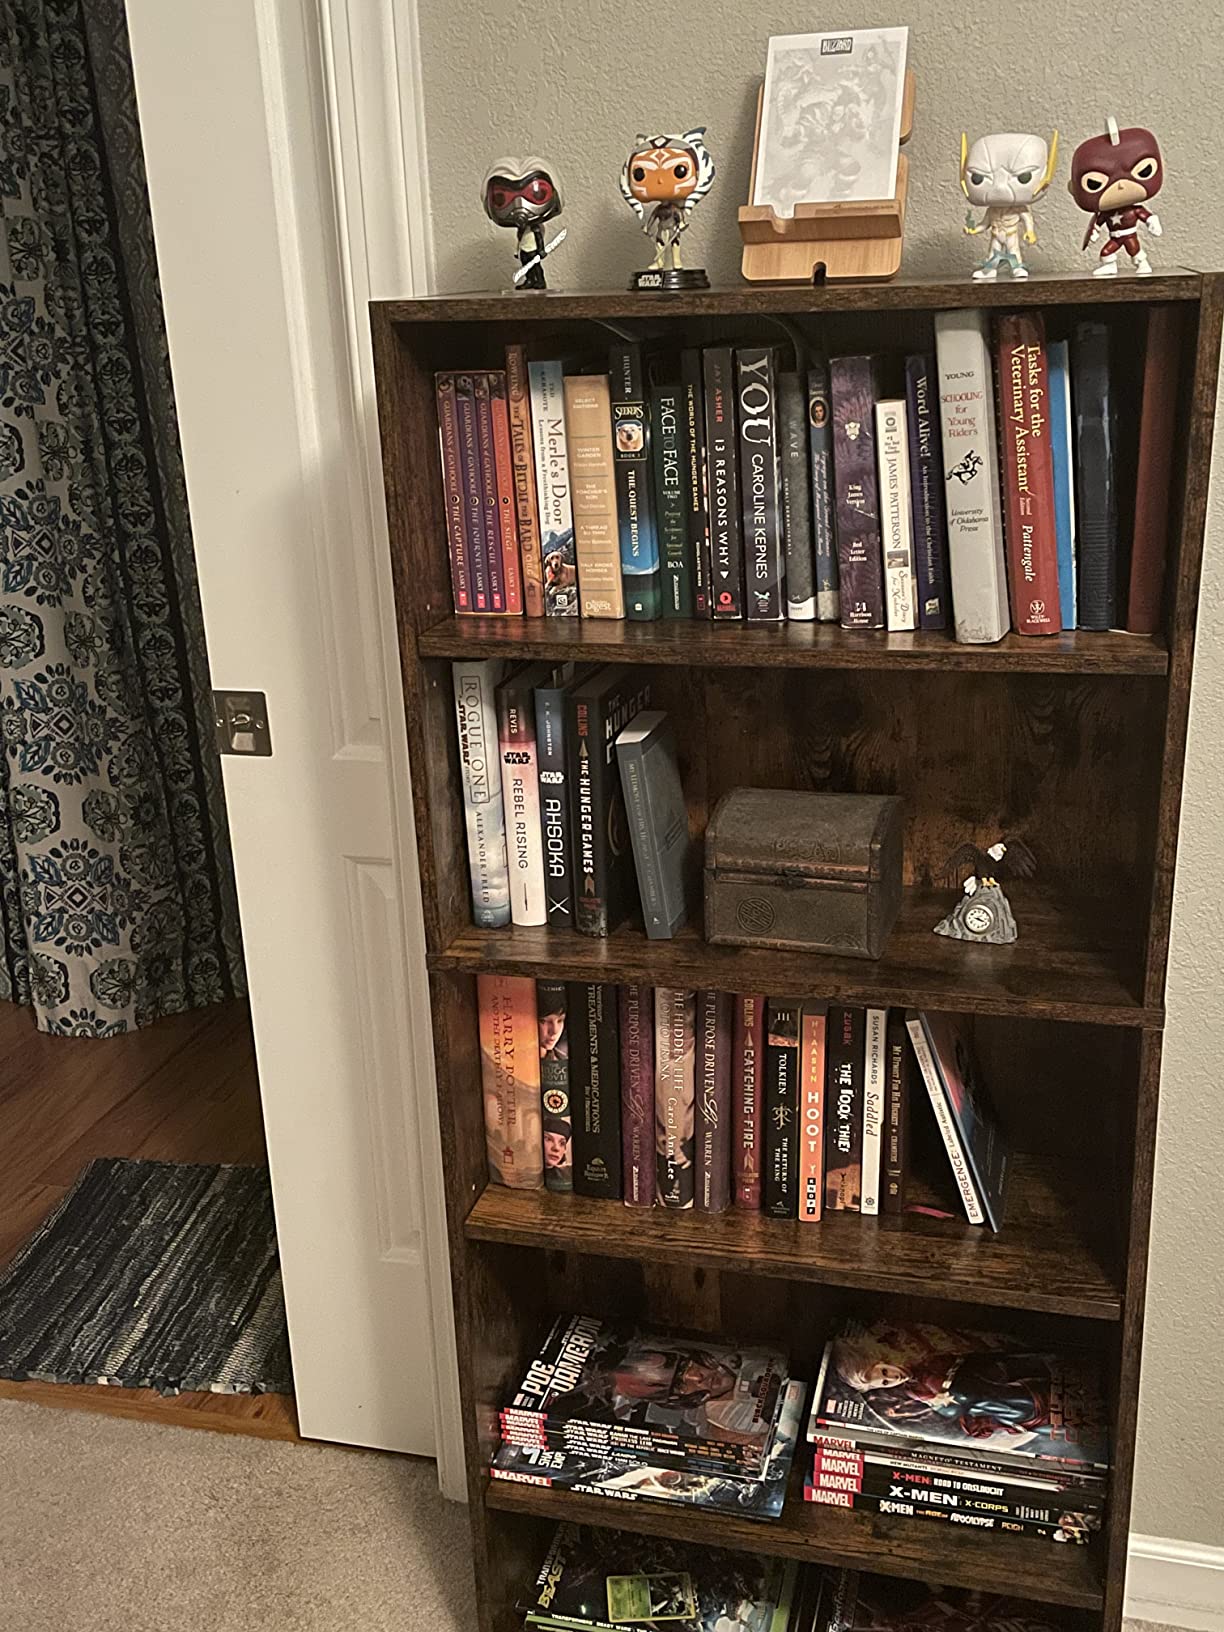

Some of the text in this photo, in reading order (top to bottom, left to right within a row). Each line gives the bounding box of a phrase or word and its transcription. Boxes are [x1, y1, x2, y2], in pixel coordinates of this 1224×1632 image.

[822, 39, 852, 53] BLIZZARD
[638, 279, 662, 287] WARS
[508, 353, 520, 396] ROWLING
[623, 355, 631, 394] HUNTER
[944, 371, 975, 380] YOUNG
[1027, 344, 1045, 438] Tasks for the
[714, 388, 724, 423] ASHER
[740, 355, 771, 447] YOU
[941, 390, 983, 402] SCHOOLING
[955, 405, 968, 414] for
[660, 397, 676, 435] FACE
[689, 428, 696, 438] OF
[916, 376, 932, 457] Word Alive!
[946, 416, 976, 428] Young
[948, 427, 978, 438] Riders
[1010, 344, 1031, 493] Veterinary Assistant
[788, 420, 799, 458] WAVE
[512, 420, 525, 453] TALES
[520, 518, 532, 551] BARD
[547, 418, 567, 525] Merle's Door
[663, 450, 679, 486] FACE
[887, 458, 898, 490] JAMES
[541, 469, 550, 510] Freethinking
[715, 439, 729, 566] 13 REASONS WHY
[922, 475, 931, 517] Introduction
[503, 508, 514, 550] THE SIEGE
[627, 470, 639, 557] THE QUEST BEGINS
[751, 453, 768, 579] CAROLINE KEPNES
[889, 492, 901, 549] PATTERSON
[925, 525, 933, 536] the
[951, 508, 984, 516] University
[956, 516, 989, 525] Oklahoma
[452, 505, 466, 566] THE CAPTURE
[470, 507, 482, 569] THE JOURNEY
[486, 509, 497, 564] THE RESCUE
[926, 537, 935, 567] Christian
[1020, 525, 1037, 582] Pattengale
[585, 601, 611, 612] Digest
[458, 697, 470, 766] STAR WARS
[509, 708, 518, 734] REVIS
[577, 704, 588, 737] COLLINS
[464, 681, 487, 799] ROGUE ONE
[540, 771, 564, 779] STAR
[513, 778, 529, 869] REBEL RISING
[580, 759, 594, 874] THE HUNGER GAMES
[545, 799, 565, 877] AHSOKA
[475, 811, 490, 903] ALEXANDER FREED
[587, 985, 598, 1055] TREATMENTS
[744, 998, 754, 1027] COLLINS
[843, 1012, 853, 1046] ZUSAK
[871, 1015, 879, 1042] SUSAN
[502, 996, 517, 1125] HARRY POTTER
[629, 1000, 640, 1088] PURPOSE DRIVEN
[661, 1040, 671, 1081] FRANK
[673, 1013, 684, 1091] HIDDEN LIFE
[704, 1004, 716, 1094] PURPOSE DRIVEN
[810, 1020, 819, 1083] HIAASEN
[778, 1053, 787, 1095] TOLKIEN
[591, 1063, 601, 1133] MEDICATIONS
[743, 1050, 754, 1149] CATCHING FIRE
[837, 1063, 854, 1153] THE BOOK THIEF
[866, 1091, 880, 1137] Saddled
[667, 1097, 678, 1180] Carol Ann Lee
[806, 1091, 820, 1152] HOOT
[632, 1126, 640, 1161] WARREN
[704, 1131, 713, 1166] WARREN
[781, 1183, 788, 1194] OF
[806, 1177, 816, 1214] KNOPF
[549, 1314, 604, 1393] DAMERON
[520, 1360, 556, 1396] POE
[753, 1358, 776, 1423] BLACK SQUADRON
[505, 1414, 539, 1422] MARVEL
[509, 1408, 543, 1419] MARVEL
[590, 1421, 613, 1429] WARS
[563, 1444, 586, 1452] STAR
[611, 1451, 637, 1459] LANDO
[813, 1435, 853, 1449] MARVEL
[823, 1448, 862, 1461] MARVEL
[494, 1469, 552, 1487] MARVEL
[821, 1458, 860, 1476] MARVEL
[911, 1452, 950, 1463] MAGNETO
[954, 1458, 1003, 1472] TESTAMENT
[570, 1484, 638, 1500] STAR WARS
[811, 1489, 851, 1508] MARVEL
[819, 1474, 859, 1493] MARVEL
[892, 1471, 932, 1486] X-MEN:
[933, 1478, 952, 1488] ROAD
[952, 1481, 962, 1490] TO
[962, 1483, 1005, 1497] ONSLAUGHT
[879, 1499, 914, 1516] X-MEN
[950, 1512, 995, 1528] APOCALYPSE
[964, 1499, 1010, 1513] X-CORPS
[551, 1613, 593, 1626] TRANSFORMERS
